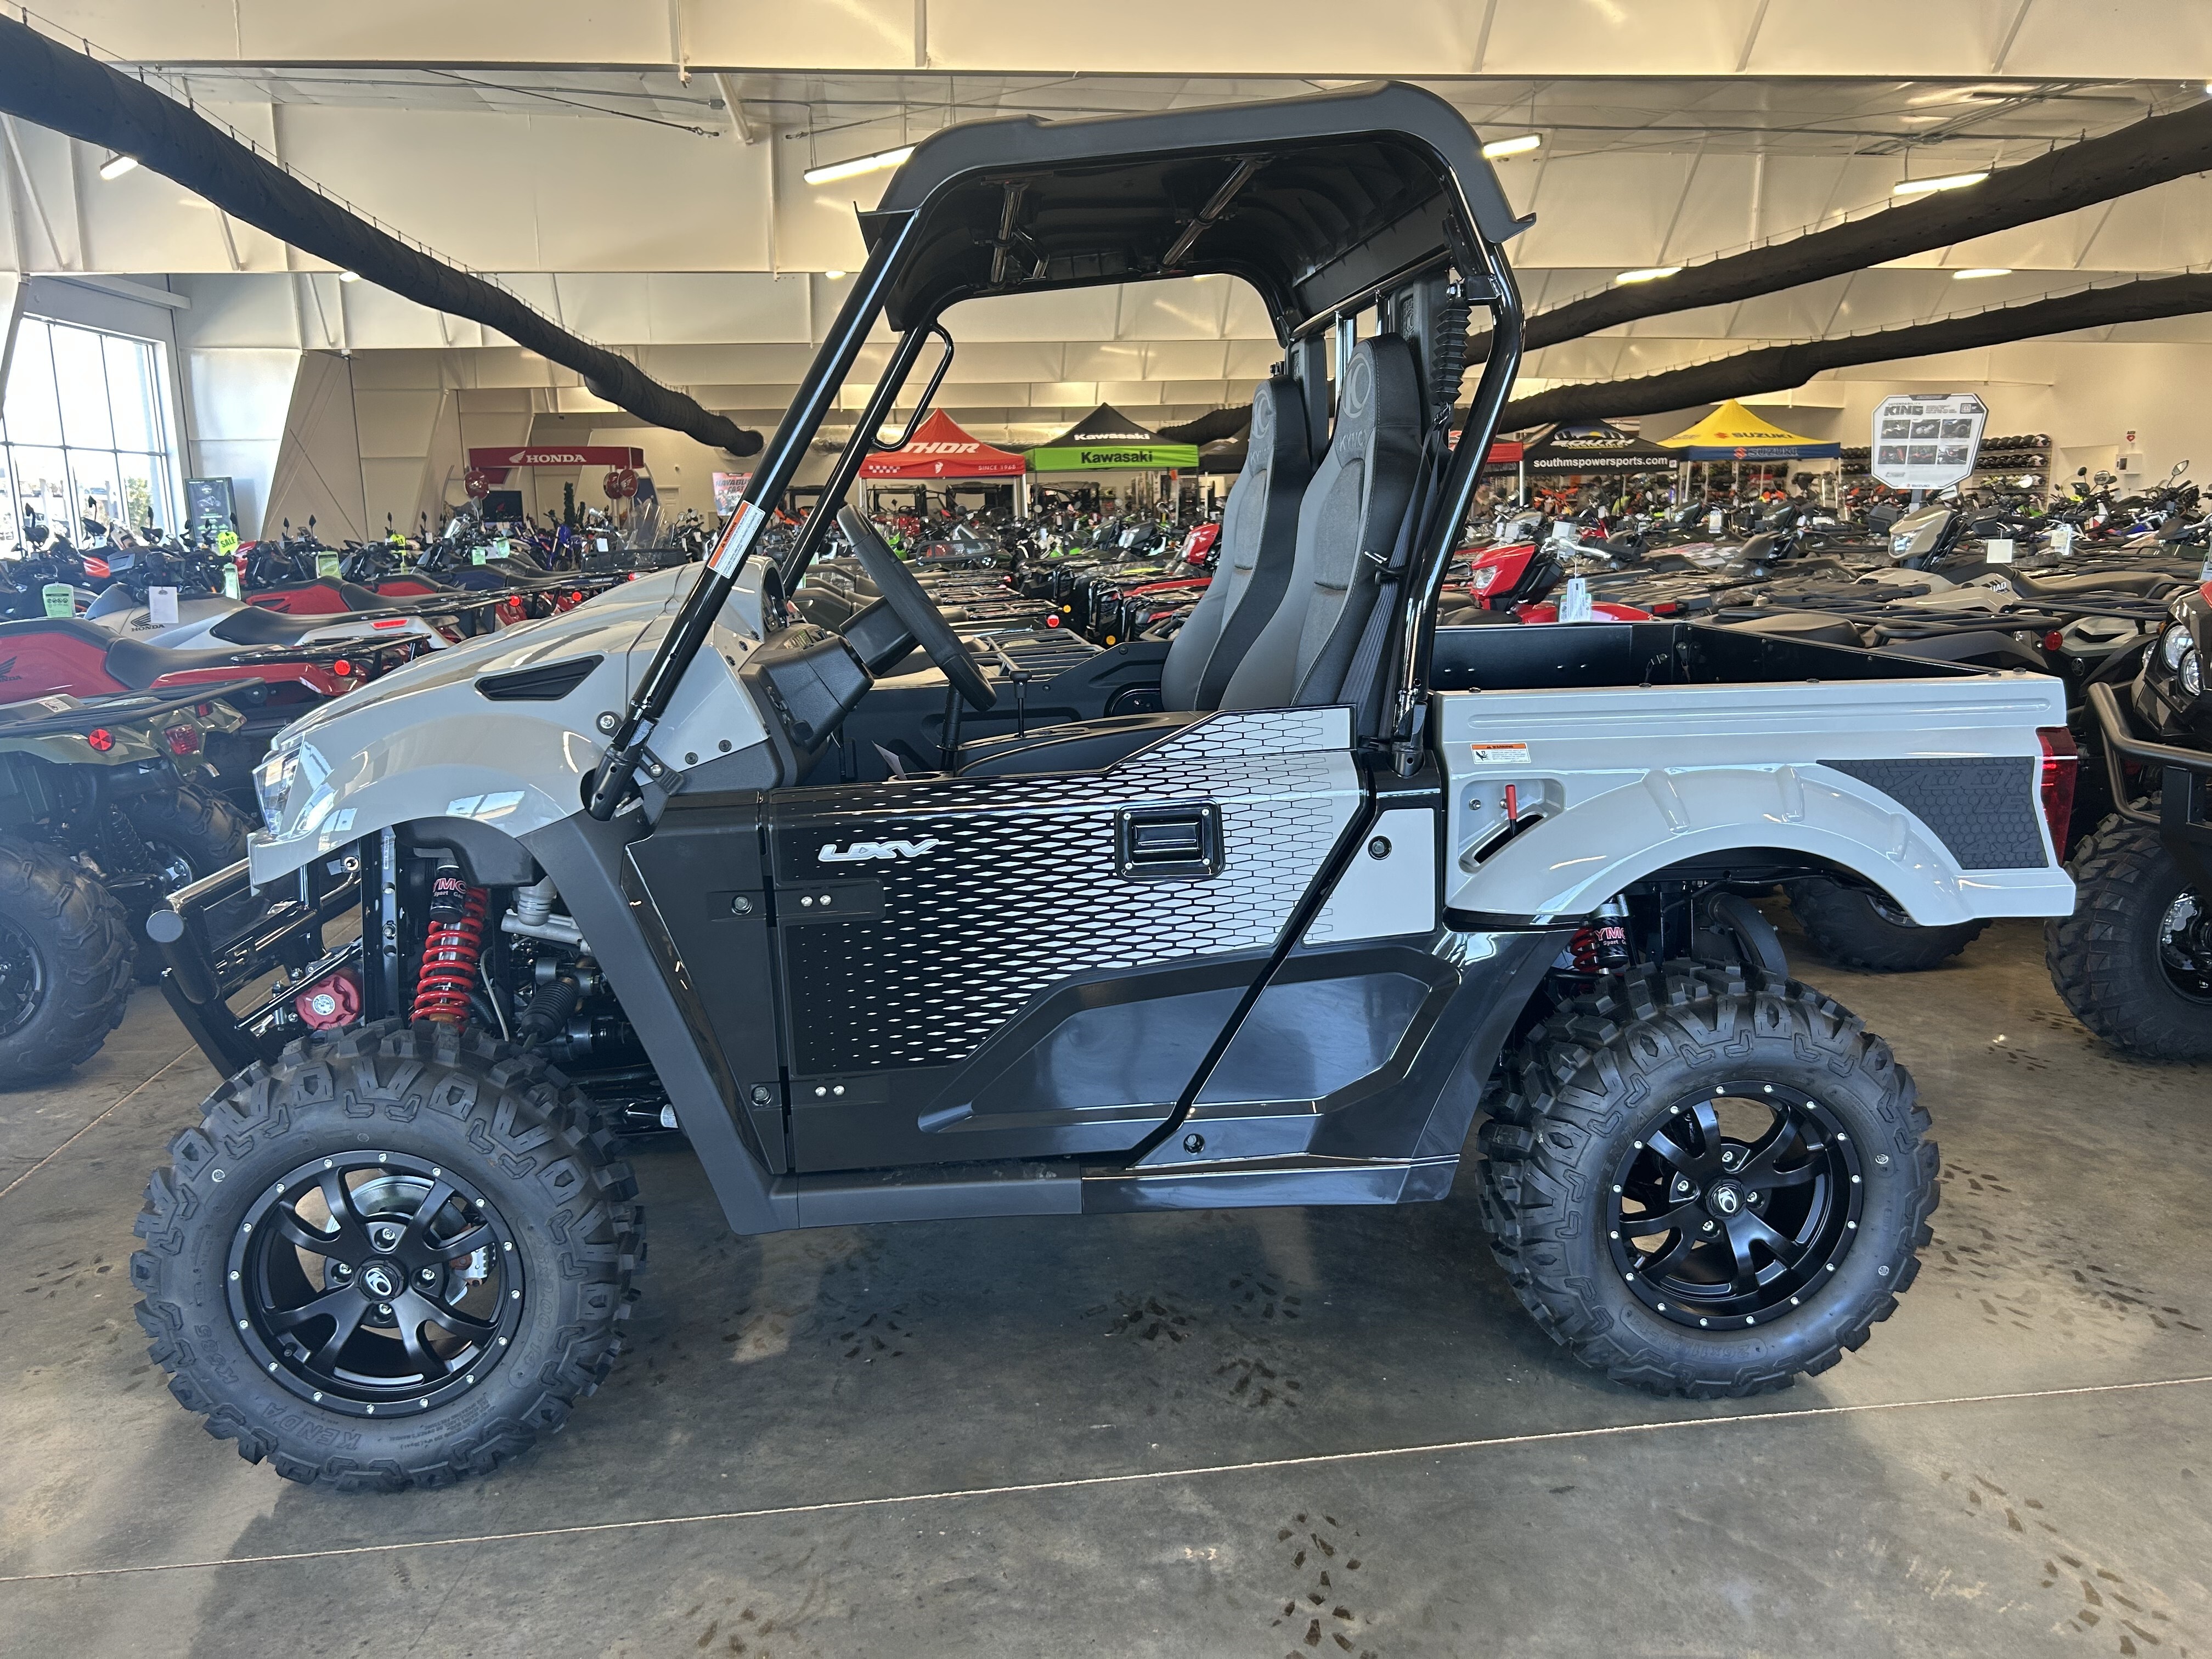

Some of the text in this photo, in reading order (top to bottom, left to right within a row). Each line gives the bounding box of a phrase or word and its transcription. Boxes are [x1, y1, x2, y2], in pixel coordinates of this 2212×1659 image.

[1884, 405, 1923, 416] KING
[1339, 429, 1367, 452] KYMCO
[900, 442, 980, 454] THOR
[1747, 447, 1799, 458] SUZUKI
[526, 454, 587, 463] HONDA
[1081, 450, 1153, 464] Kawasaki
[1533, 456, 1668, 469] southmspowersports.com
[723, 521, 738, 543] WARNING
[221, 537, 236, 548] SALE
[1990, 582, 2007, 592] UAD
[131, 624, 166, 632] HONDA
[193, 1324, 239, 1386] K585
[261, 1402, 362, 1451] KENDA
